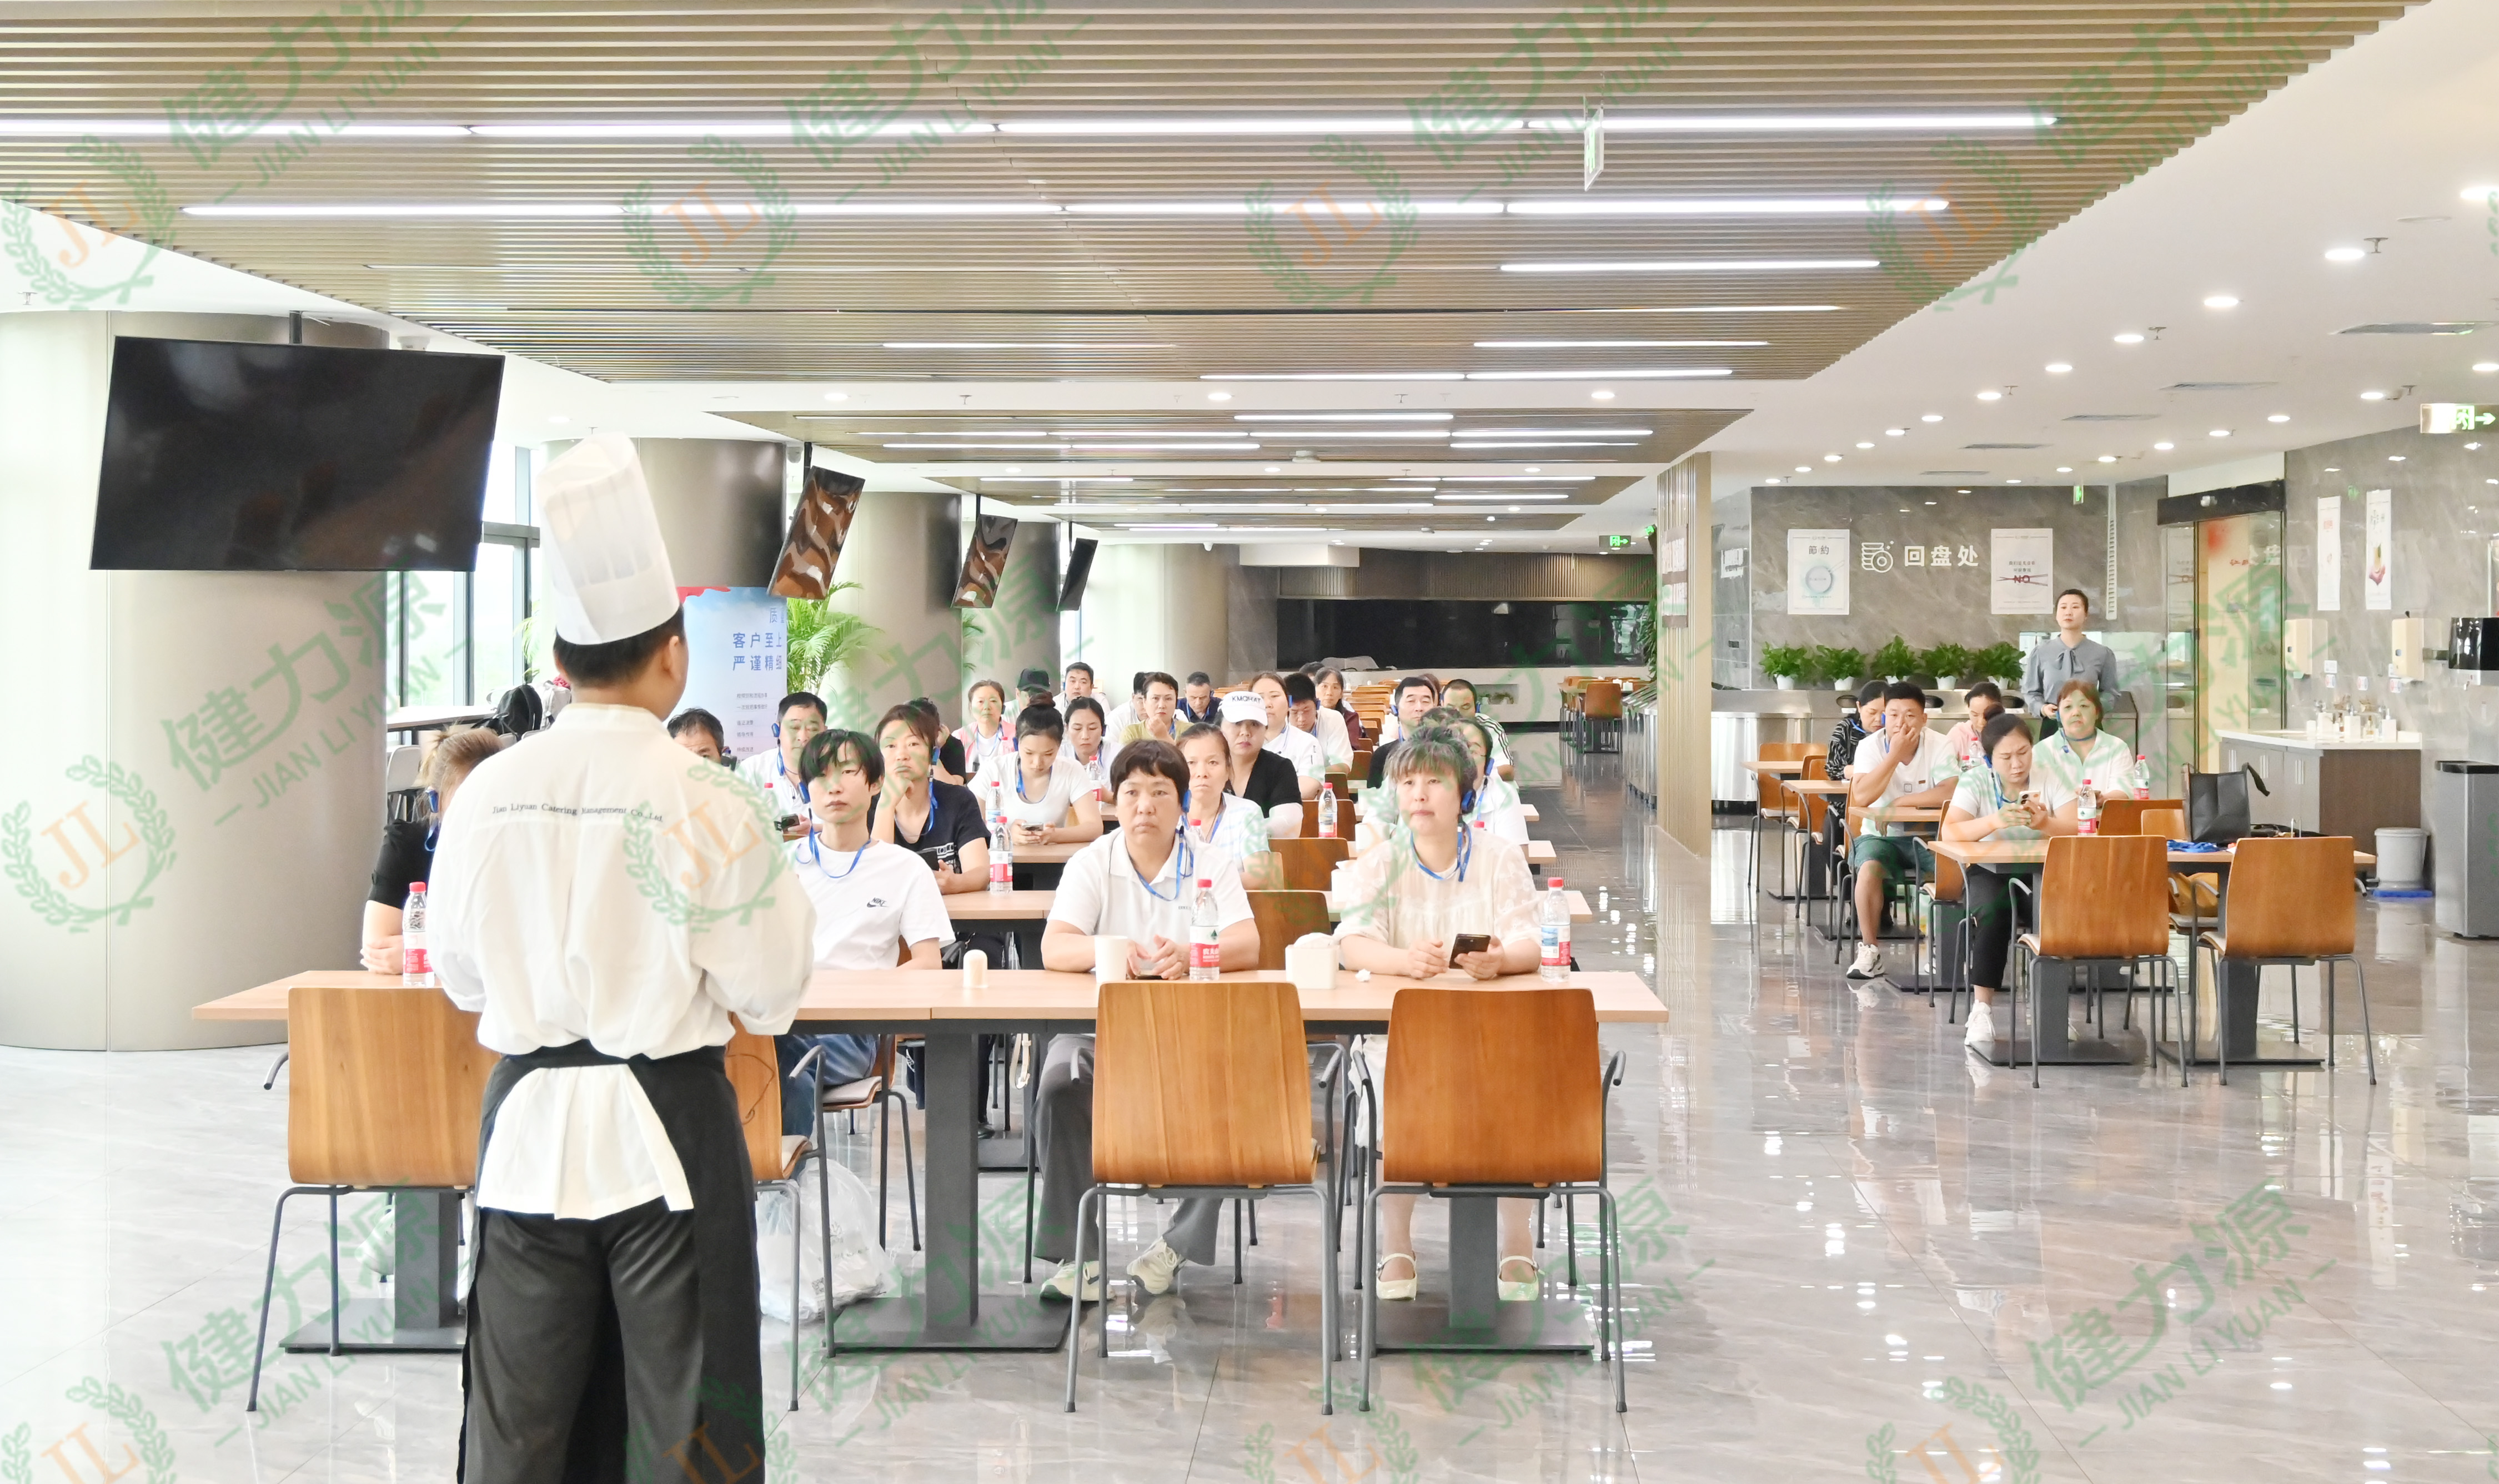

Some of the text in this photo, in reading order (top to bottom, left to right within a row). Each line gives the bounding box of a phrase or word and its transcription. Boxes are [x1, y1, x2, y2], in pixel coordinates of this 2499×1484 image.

[1809, 545, 1829, 555] 節約
[1904, 545, 1979, 567] 回盘处
[2014, 575, 2030, 583] NO
[733, 632, 782, 648] 客户至上
[733, 655, 782, 671] 严谨精细
[541, 803, 578, 816] Catering
